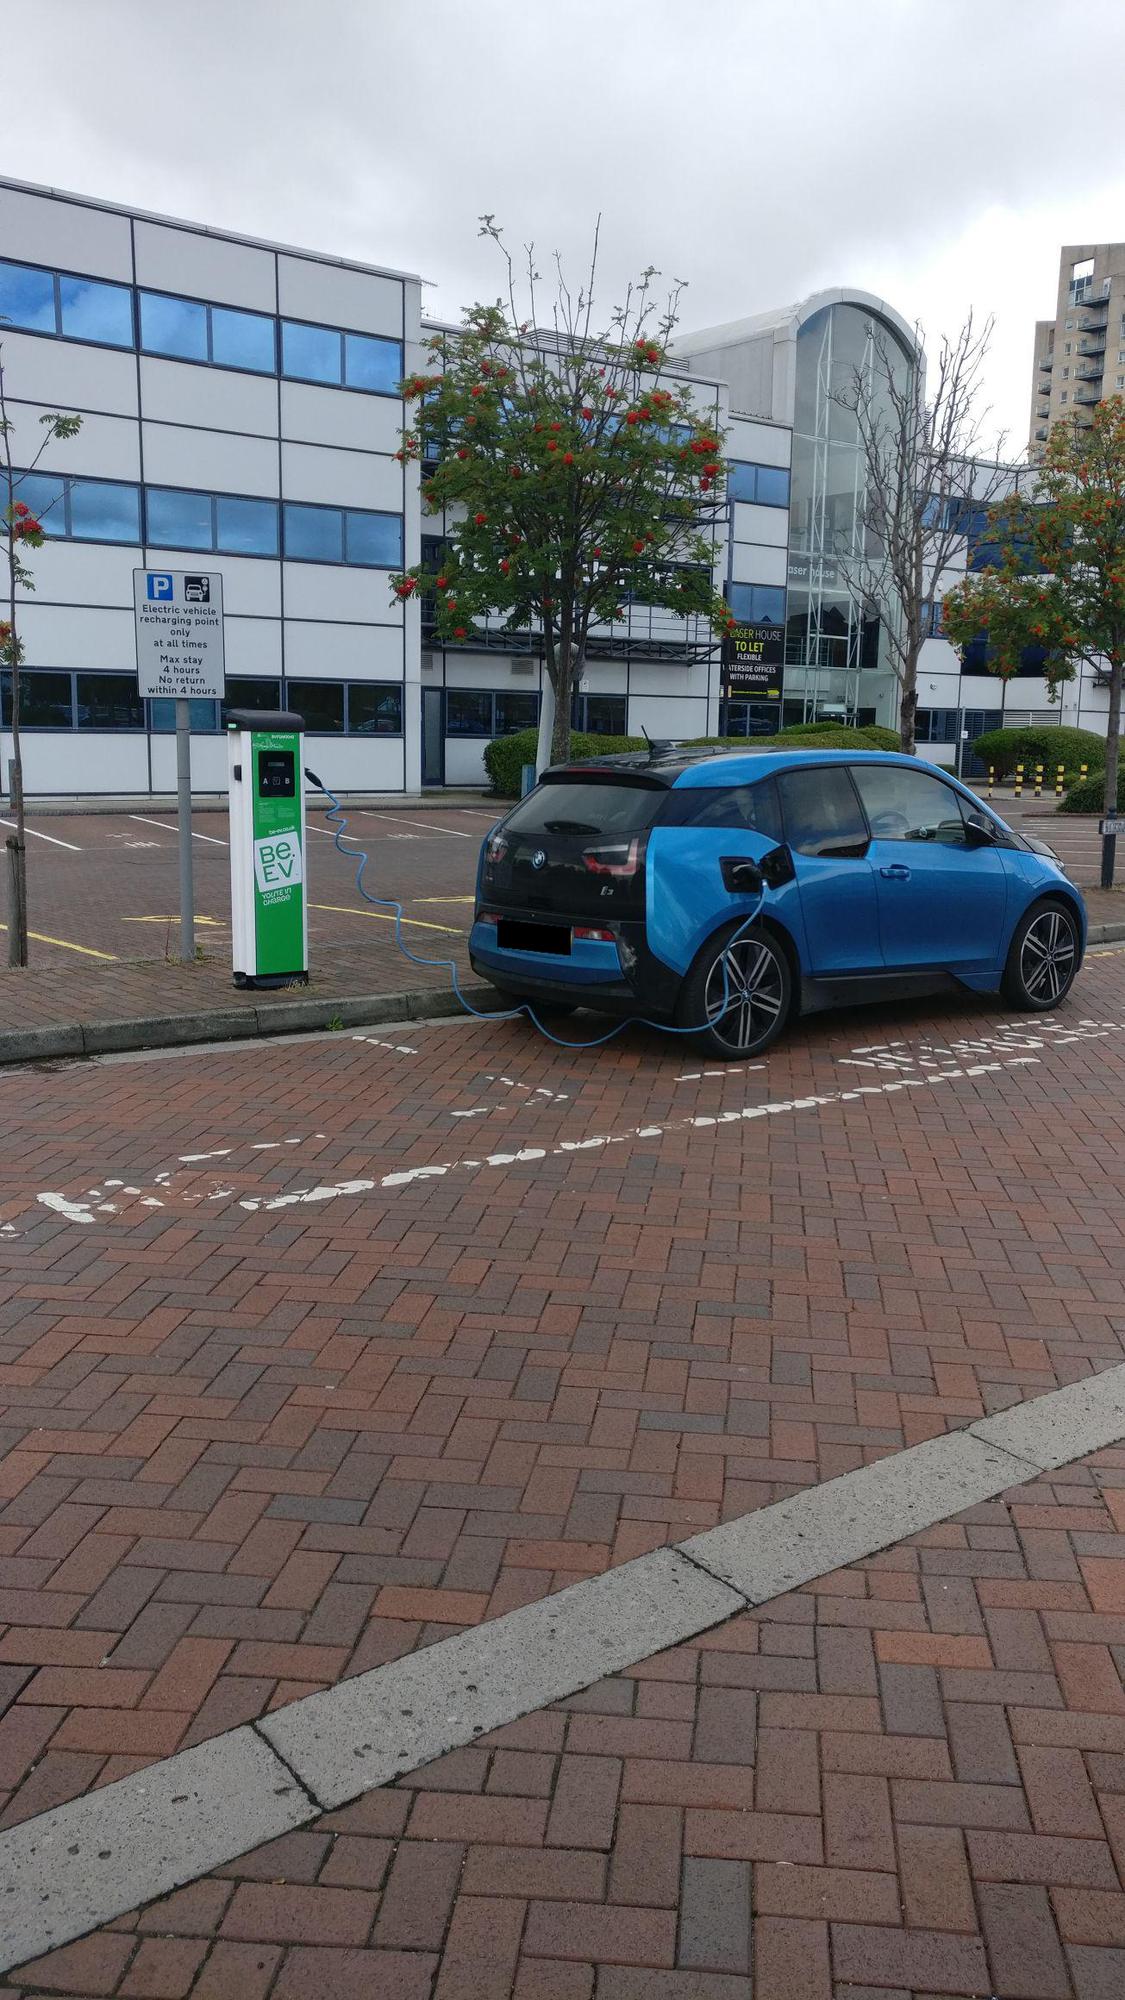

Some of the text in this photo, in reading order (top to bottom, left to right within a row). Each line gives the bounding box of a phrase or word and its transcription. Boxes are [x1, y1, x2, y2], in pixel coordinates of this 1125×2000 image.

[153, 576, 169, 598] P
[142, 604, 217, 616] Electric vehicle
[140, 615, 219, 626] recharging point
[170, 628, 190, 637] only
[755, 629, 782, 641] HOUSE
[167, 640, 178, 648] all
[182, 640, 208, 648] times
[735, 640, 764, 652] TO LET
[160, 655, 203, 665] Max stay
[737, 653, 762, 661] FLEXIBLE
[163, 665, 200, 674] 4 hours
[722, 664, 776, 674] TERSIDE OFFICES
[159, 676, 205, 685] No return
[745, 674, 769, 682] PARKING
[148, 686, 217, 695] within 4 hours
[263, 860, 294, 883] EV
